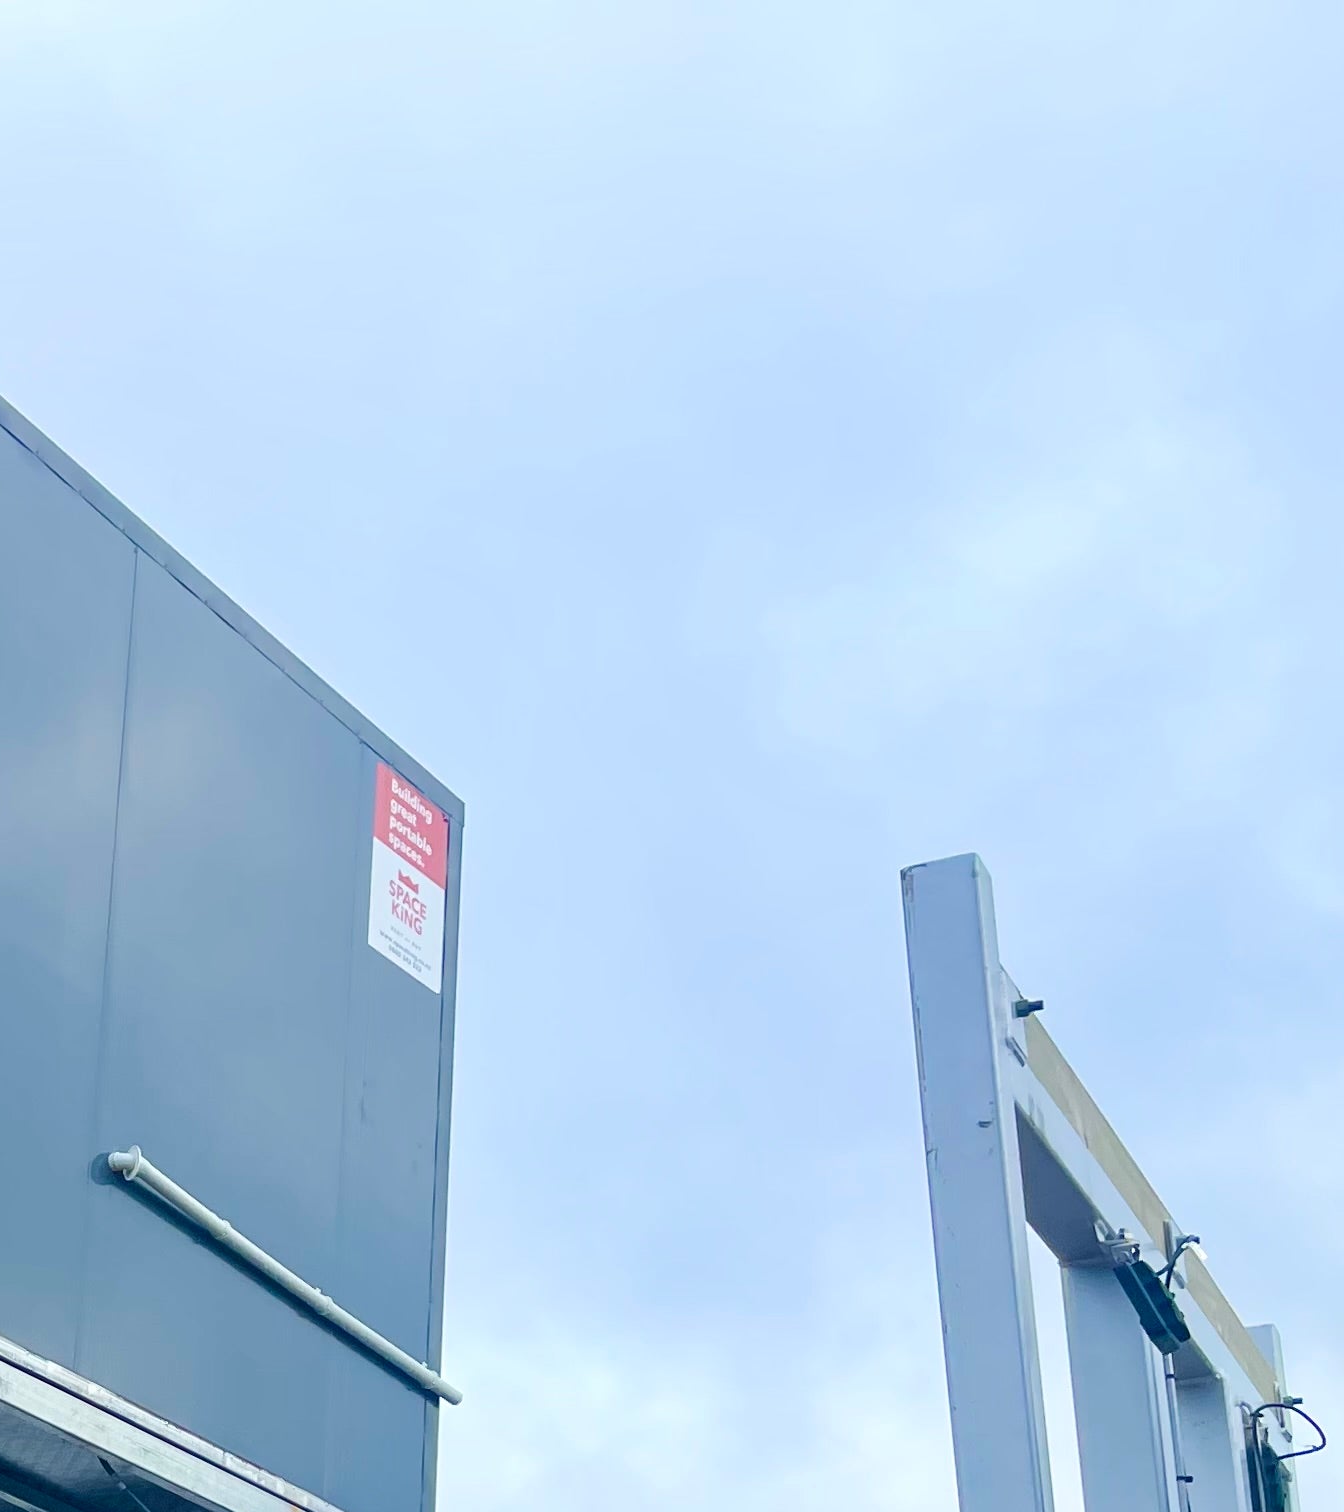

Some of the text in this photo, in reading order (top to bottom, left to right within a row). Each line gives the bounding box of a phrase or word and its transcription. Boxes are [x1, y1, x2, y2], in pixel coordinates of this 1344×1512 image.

[390, 799, 417, 827] great
[391, 778, 433, 825] Building
[388, 833, 425, 868] spaces.
[389, 815, 432, 856] portable
[389, 880, 427, 920] SPACE
